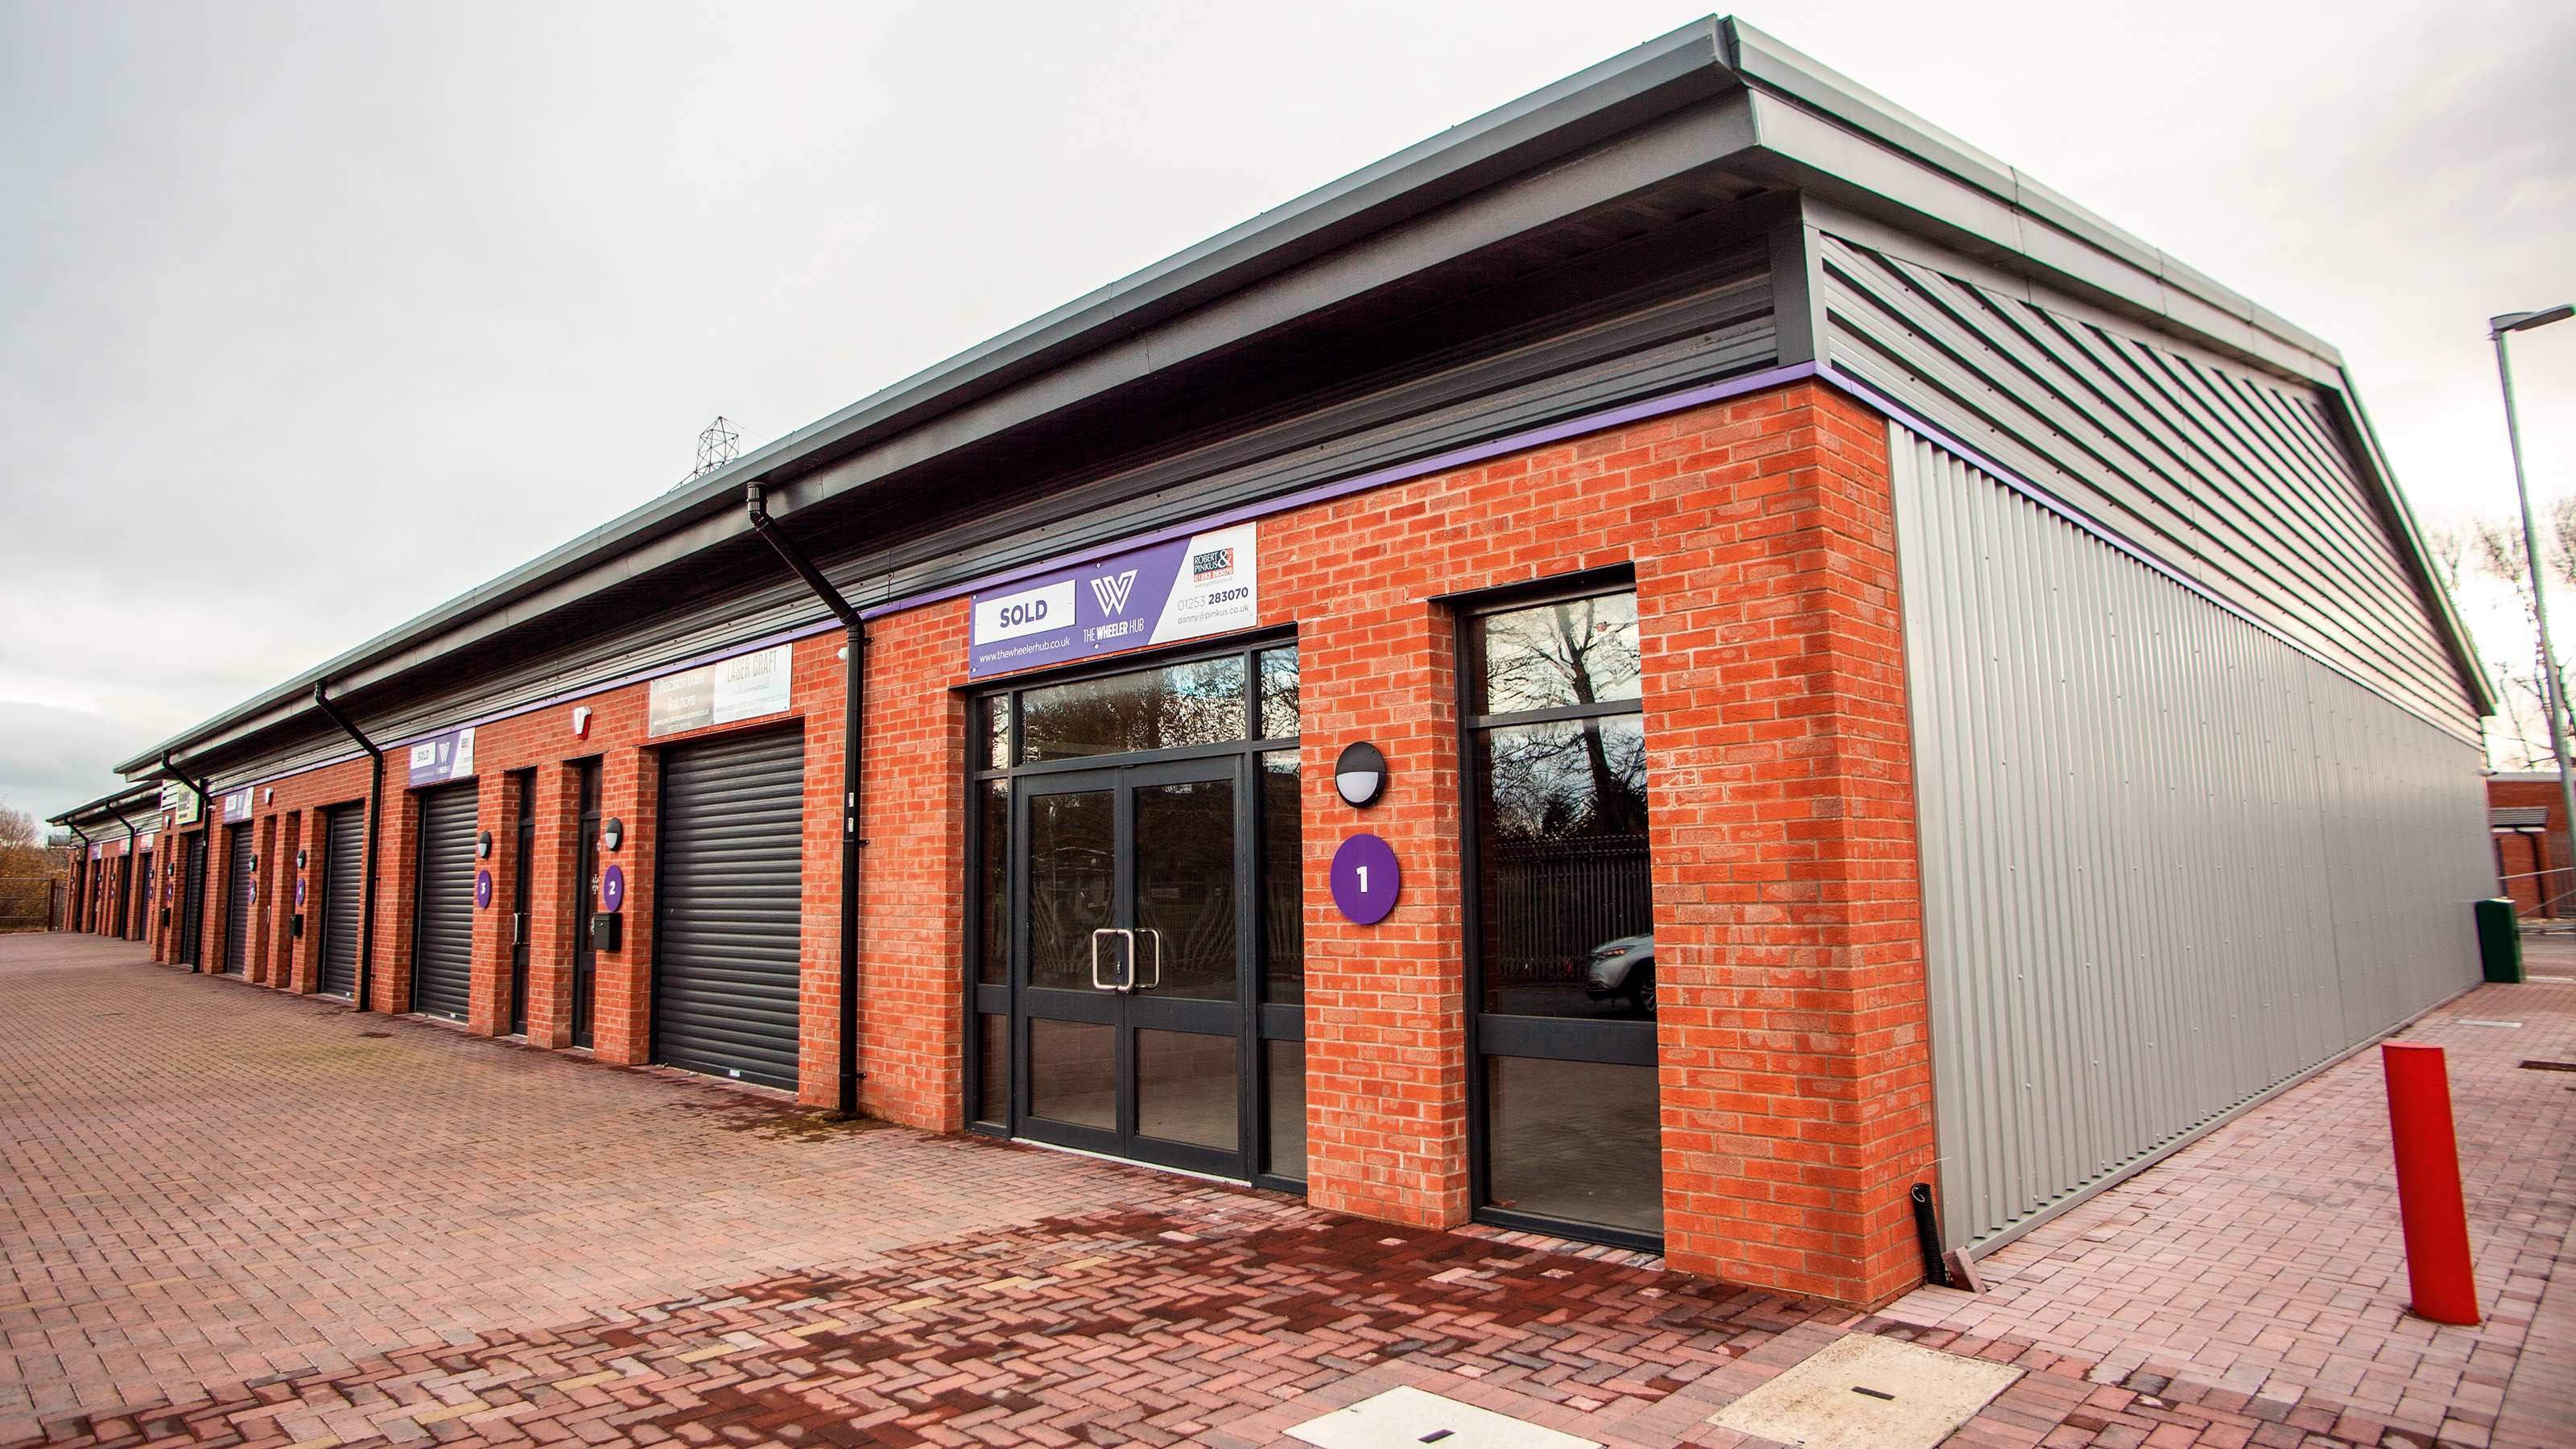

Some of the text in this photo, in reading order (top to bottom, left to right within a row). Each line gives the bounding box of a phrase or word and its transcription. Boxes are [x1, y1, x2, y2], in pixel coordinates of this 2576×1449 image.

[1195, 551, 1218, 565] ROBERT
[1195, 561, 1218, 573] PINKUS
[1195, 568, 1233, 581] 01253 283070
[1178, 587, 1249, 611] 01253 283070
[1000, 600, 1048, 628] SOLD
[1177, 603, 1249, 624] danny@pinkus.co.uk
[1083, 617, 1145, 643] THE WHEELER HUB
[979, 635, 1071, 663] www.thewheelerhub.co.uk
[727, 650, 778, 683] LASER CRAFT
[659, 671, 706, 693] Precision Laser
[668, 694, 696, 712] Solutions
[417, 749, 430, 762] SOLD
[481, 881, 486, 894] 3
[609, 881, 616, 895] 2
[1356, 865, 1368, 893] 1
